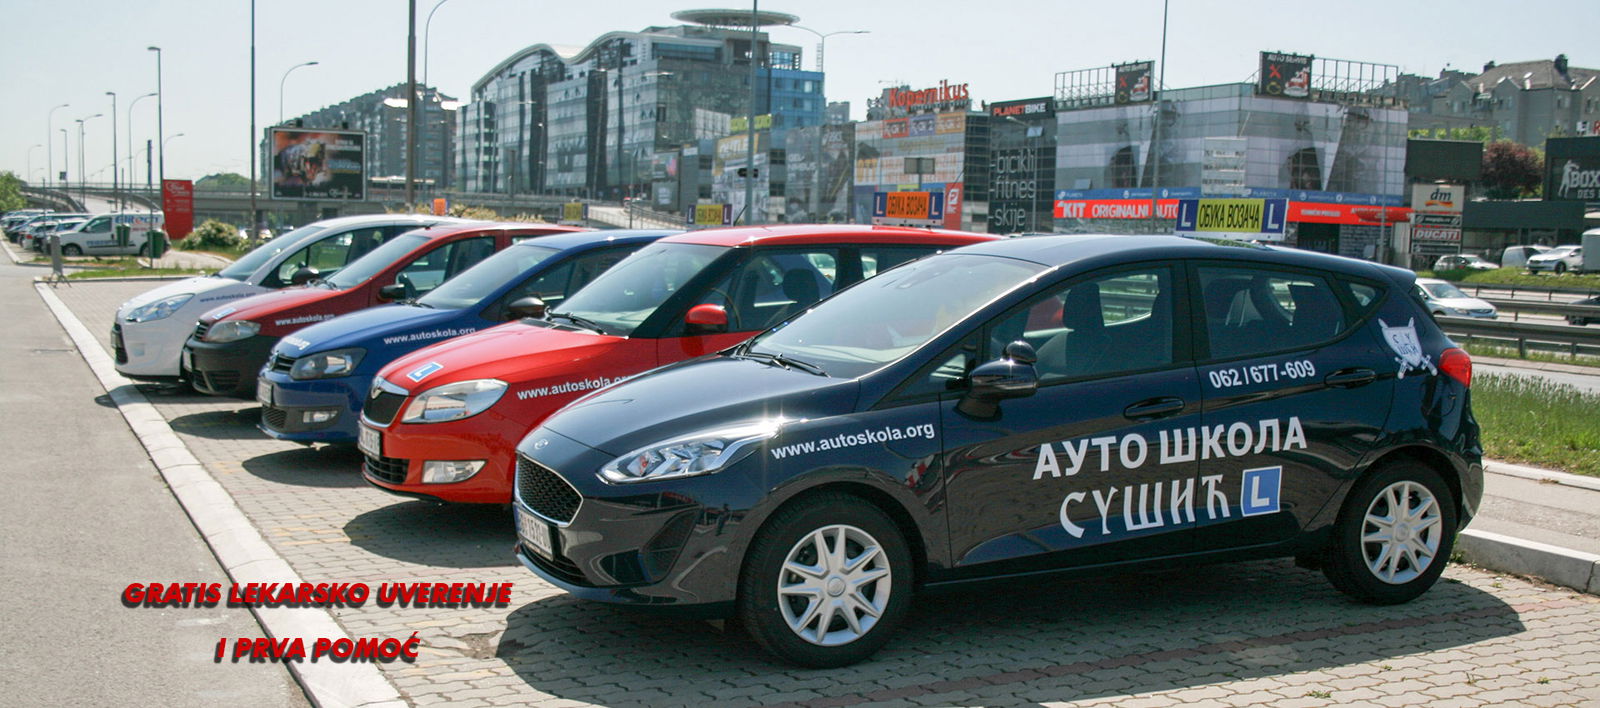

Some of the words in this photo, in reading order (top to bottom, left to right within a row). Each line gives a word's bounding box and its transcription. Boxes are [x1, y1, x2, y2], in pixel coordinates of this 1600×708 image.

[888, 79, 969, 112] Kopernikus
[876, 196, 884, 215] L
[931, 196, 939, 215] L
[1430, 188, 1452, 201] dm
[1063, 202, 1087, 218] KIT
[1091, 204, 1149, 218] ORIGINALNI
[1181, 203, 1192, 228] L
[1199, 204, 1225, 228] ОБУКА
[1227, 204, 1260, 229] ВОЗАЧА
[1267, 203, 1280, 229] L
[1416, 230, 1458, 240] DUCATI
[384, 327, 476, 345] www.autoskola.org
[771, 423, 936, 460] www.autoskola.org
[1032, 433, 1148, 480] АУТО
[1159, 416, 1307, 465] ШКОЛА
[1251, 475, 1270, 508] L
